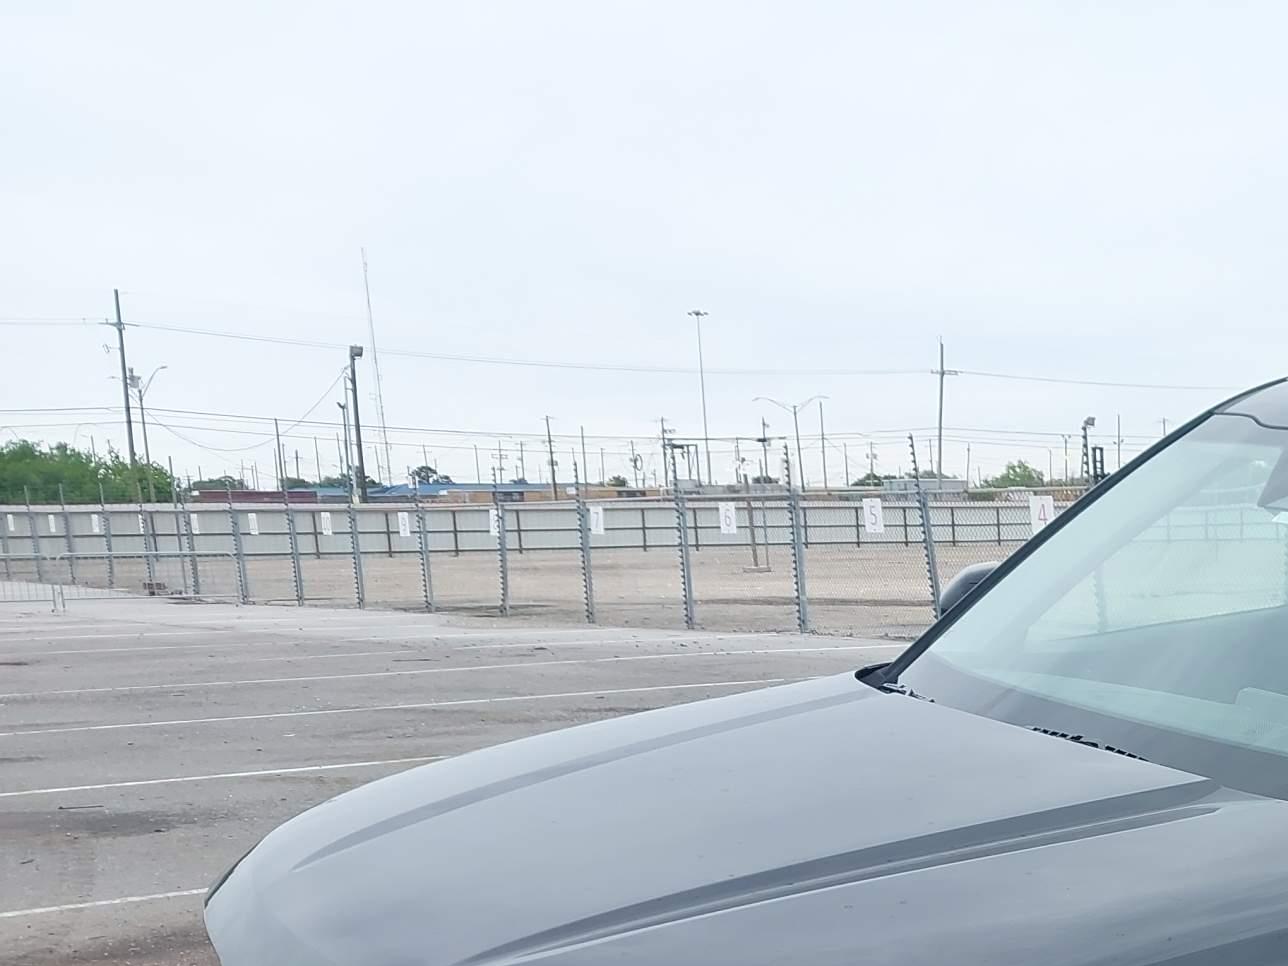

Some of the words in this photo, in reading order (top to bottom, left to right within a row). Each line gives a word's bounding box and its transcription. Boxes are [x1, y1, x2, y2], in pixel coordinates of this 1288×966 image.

[593, 511, 599, 528] 7
[724, 511, 731, 528] 6
[869, 505, 878, 526] 5
[1037, 503, 1048, 526] 4
